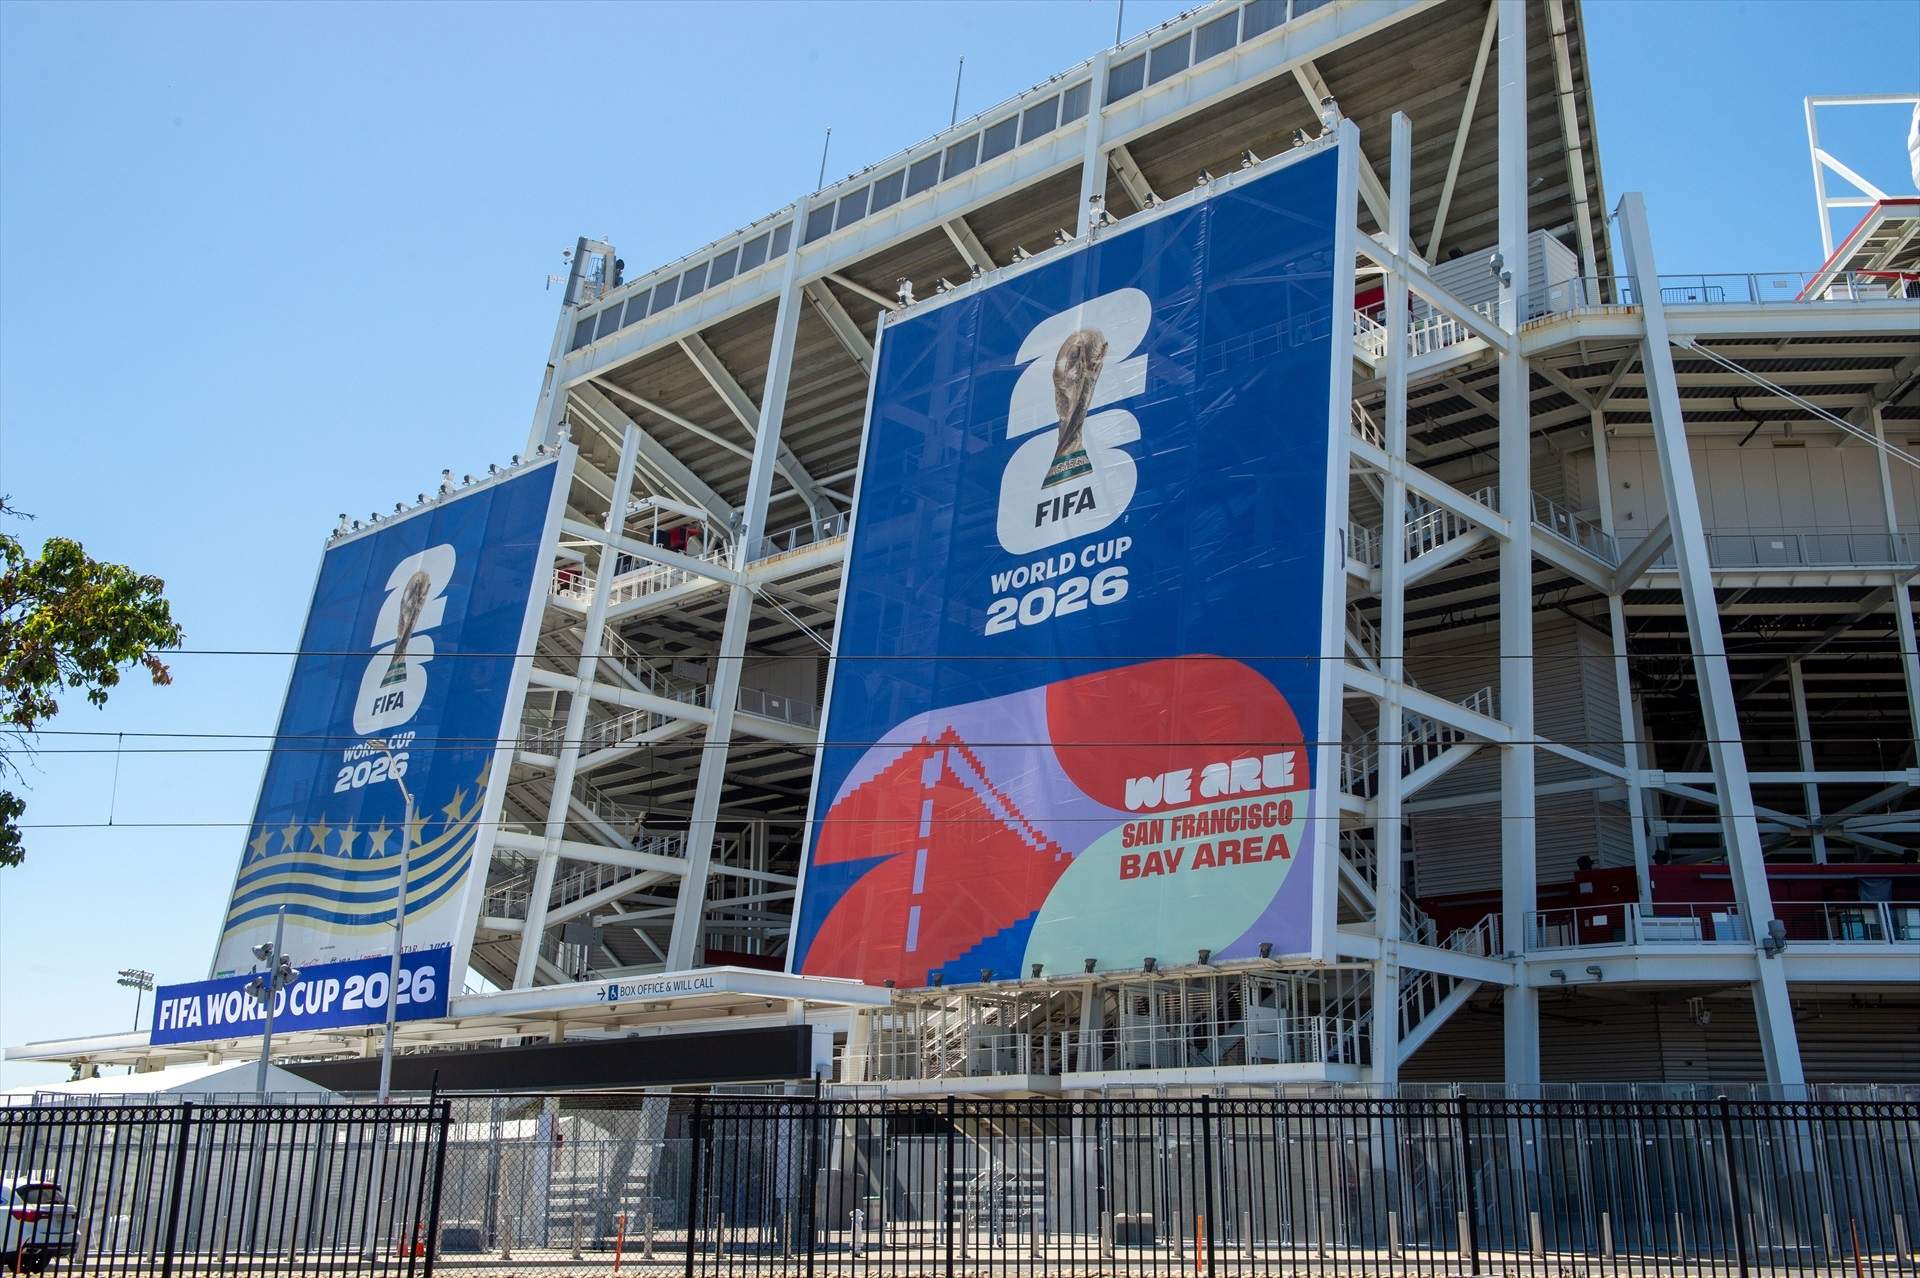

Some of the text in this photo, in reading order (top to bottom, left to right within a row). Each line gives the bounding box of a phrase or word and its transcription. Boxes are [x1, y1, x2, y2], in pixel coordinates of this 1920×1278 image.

[1034, 486, 1097, 528] FIFA
[990, 536, 1133, 595] WORLD CUP
[984, 566, 1129, 636] 2026
[371, 691, 404, 716] FIFA
[388, 730, 416, 750] CUP
[333, 752, 410, 794] 2026
[1124, 768, 1193, 811] WE
[1121, 799, 1294, 849] SAN FRANCISCO
[1119, 833, 1291, 881] BAY AREA
[158, 996, 202, 1031] FIFA
[290, 978, 340, 1016] CUP
[342, 965, 436, 1011] 2026
[620, 977, 714, 997] BOX OFFICE & WILL CALL
